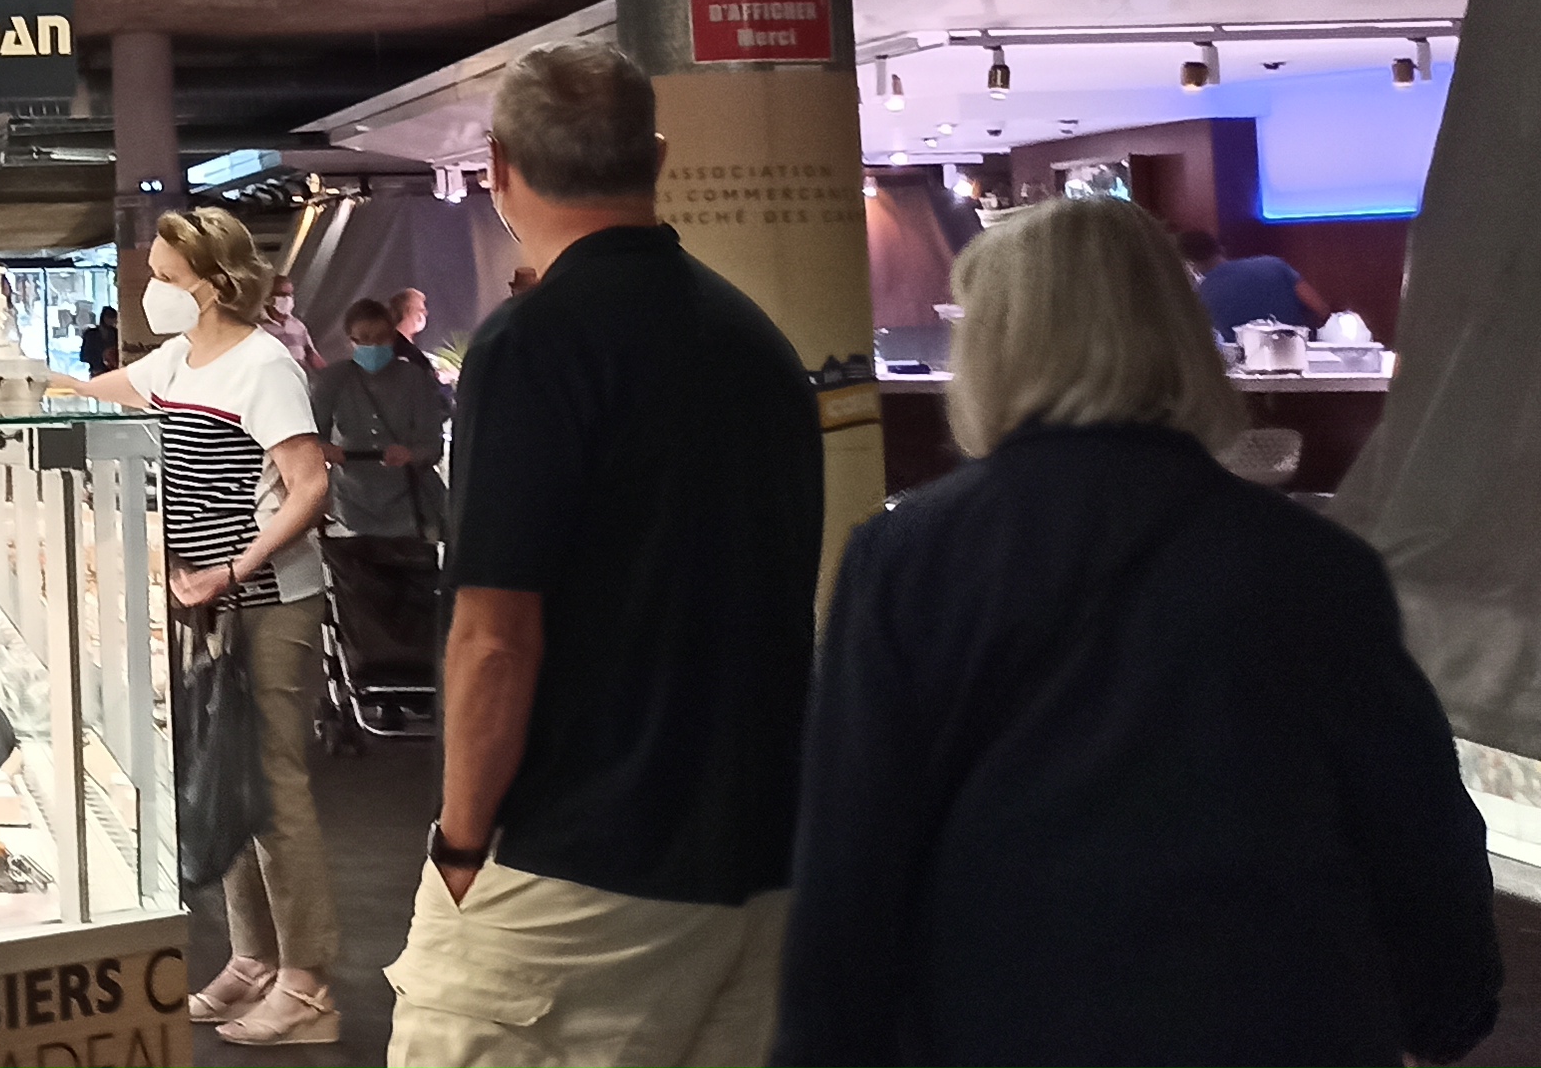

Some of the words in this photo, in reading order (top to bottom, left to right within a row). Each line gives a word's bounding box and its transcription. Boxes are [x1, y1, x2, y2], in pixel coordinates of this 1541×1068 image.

[707, 1, 819, 23] D'AFFICHER
[736, 27, 798, 48] Merci
[667, 164, 833, 181] ASSOCIATION
